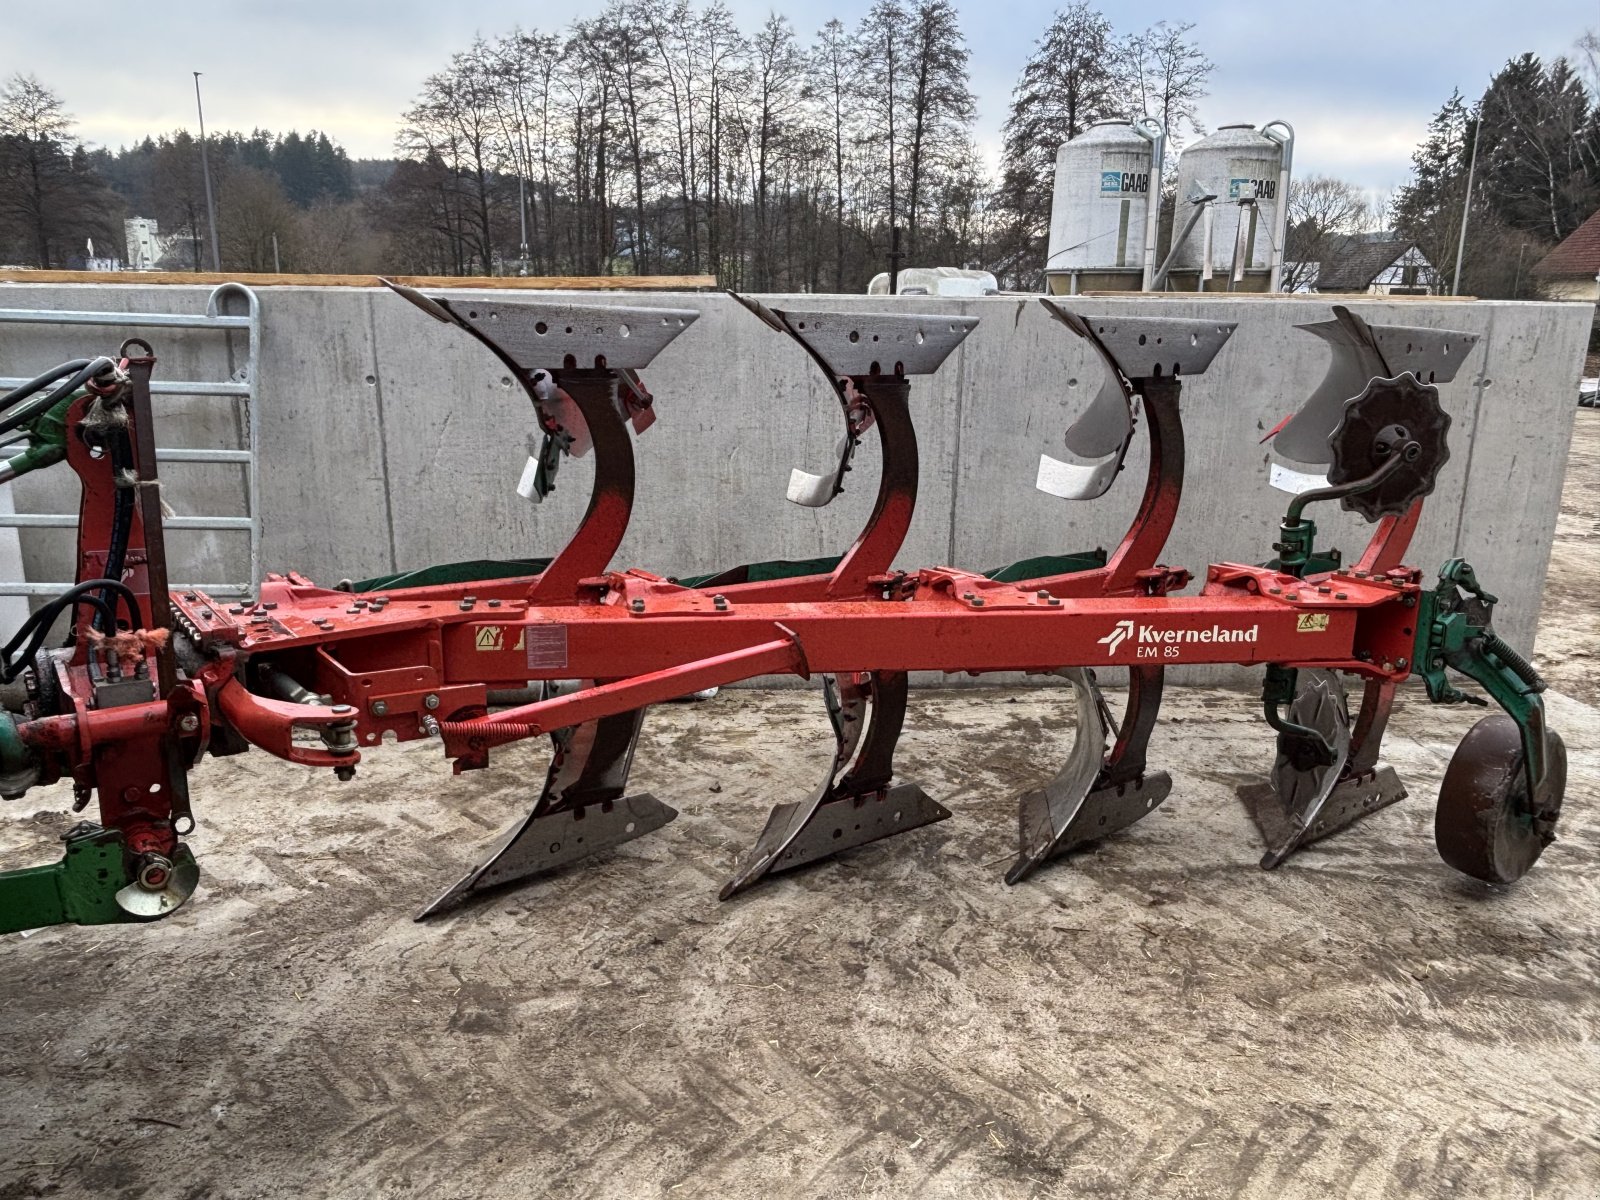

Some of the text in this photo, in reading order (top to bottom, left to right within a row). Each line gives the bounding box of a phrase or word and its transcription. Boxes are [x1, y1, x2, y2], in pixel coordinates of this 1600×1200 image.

[1121, 172, 1149, 192] GAAB
[1138, 624, 1259, 643] Kverneland
[1136, 645, 1180, 658] EM 85
